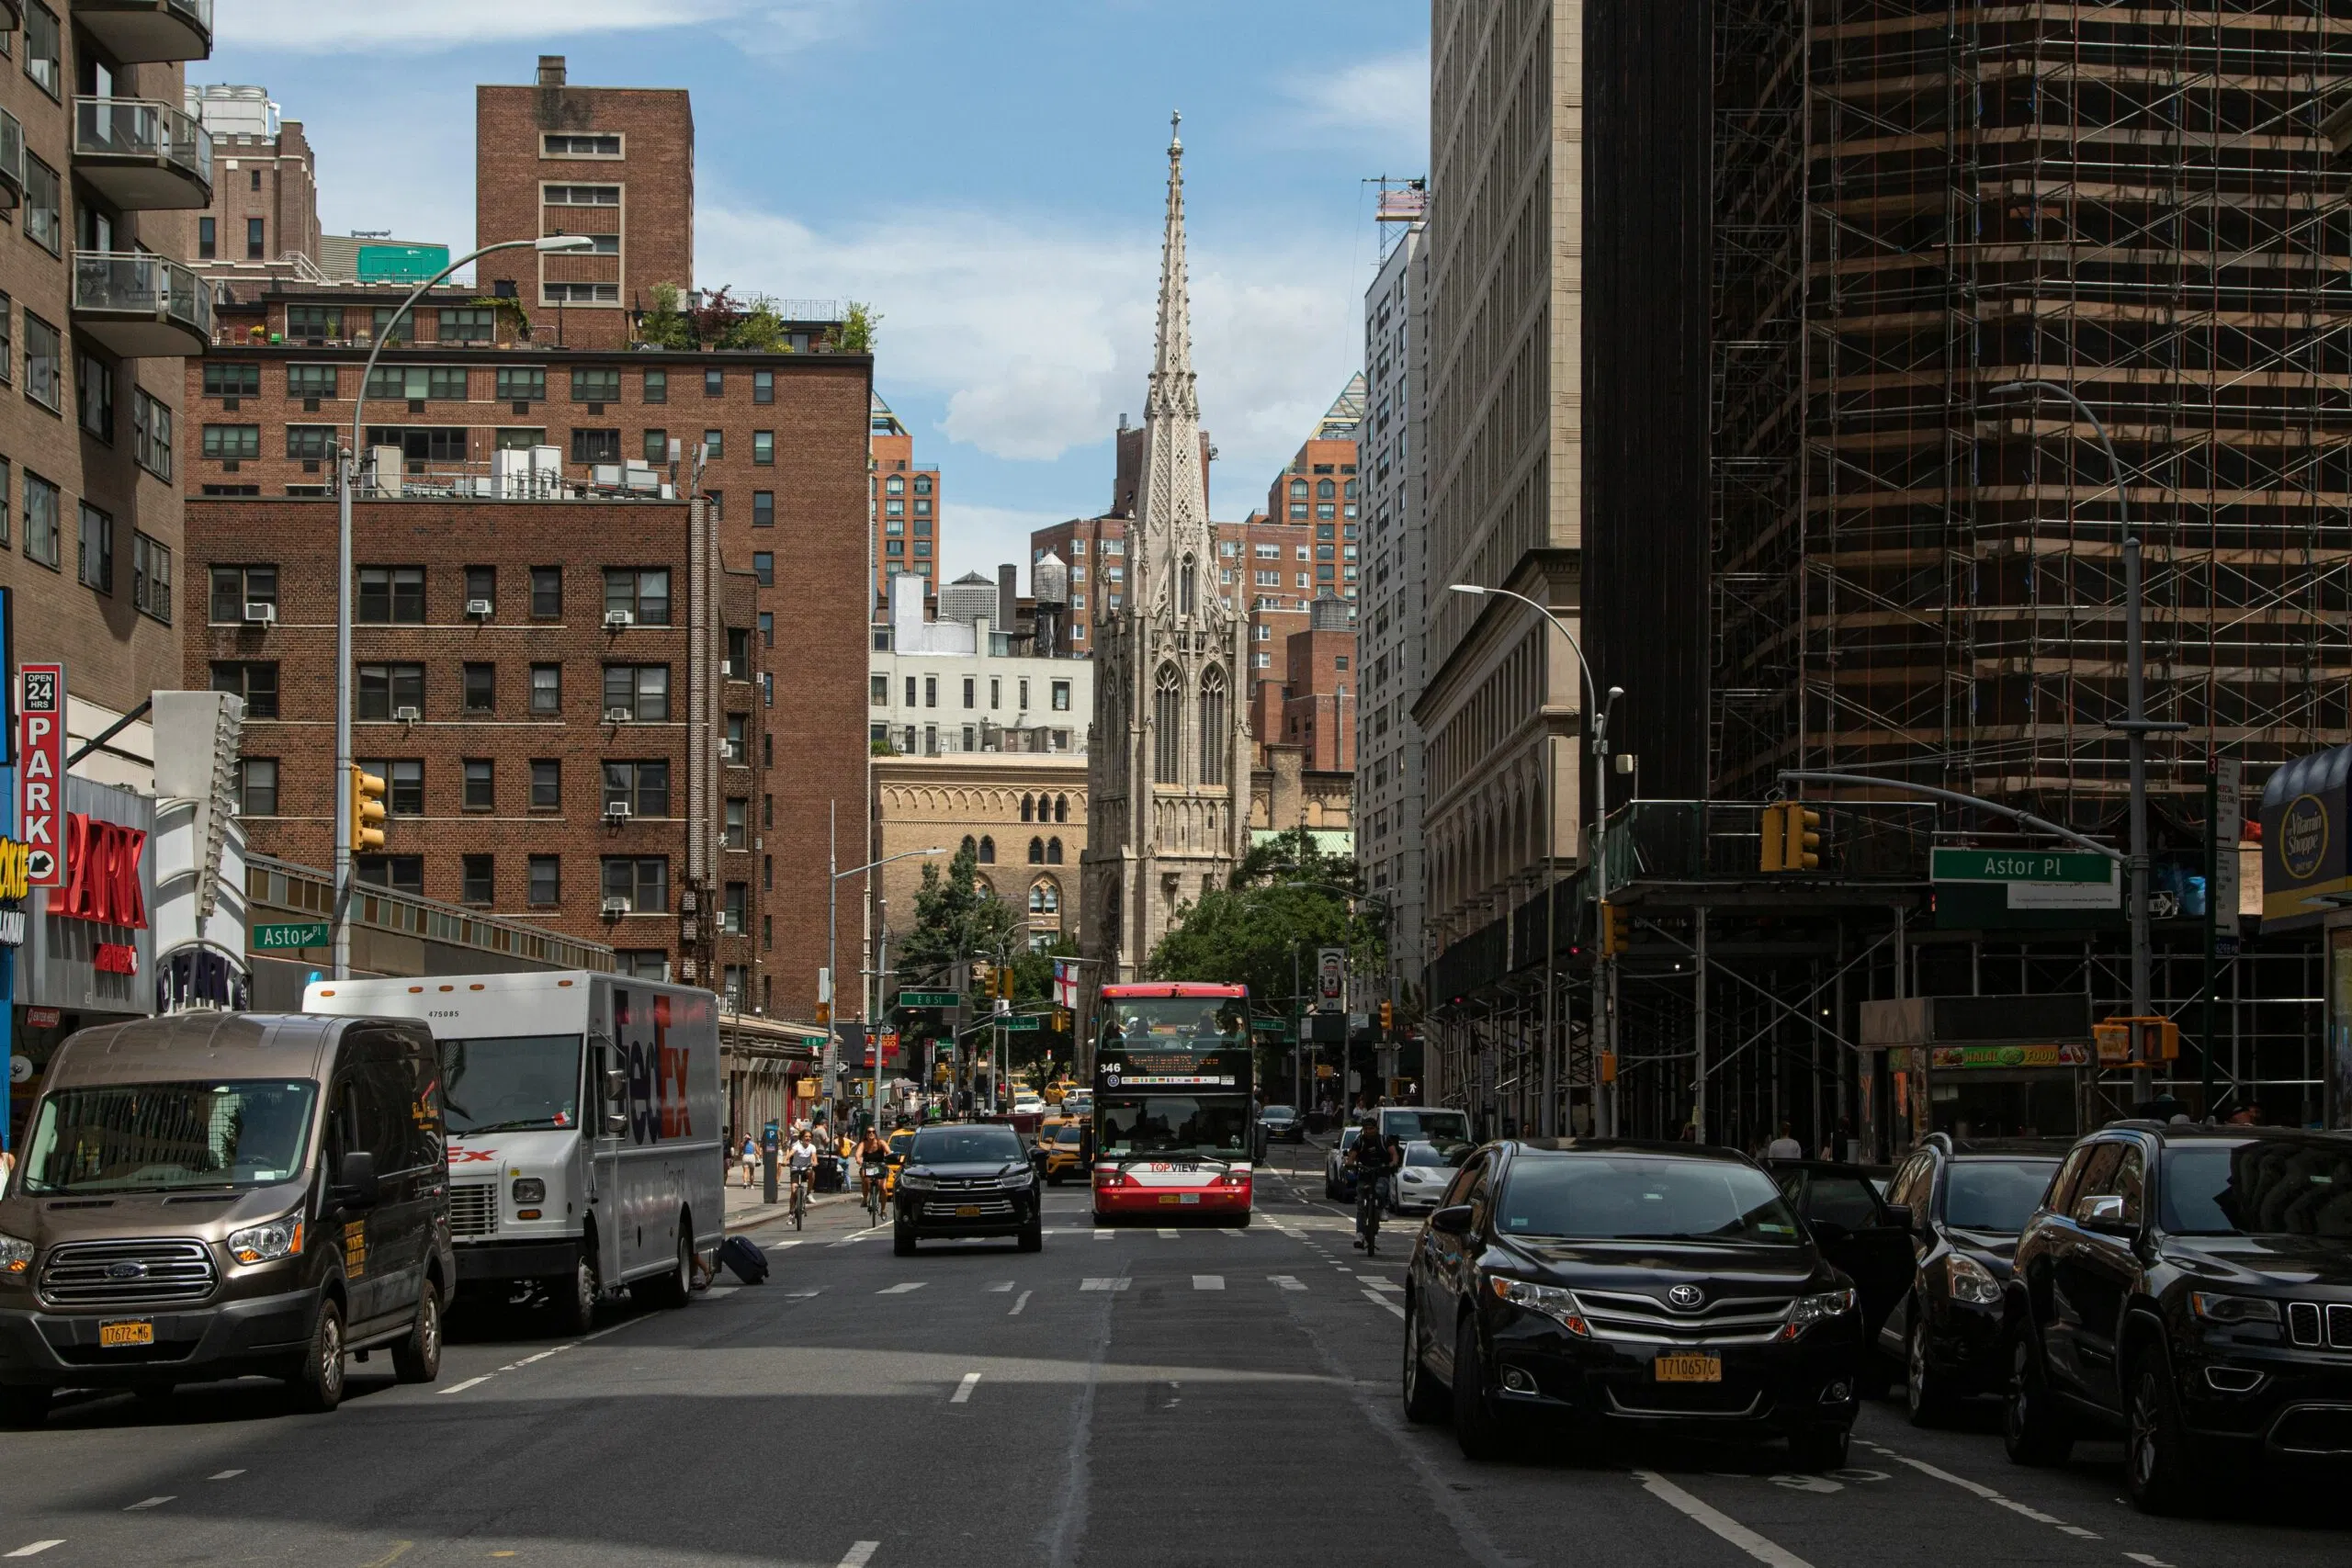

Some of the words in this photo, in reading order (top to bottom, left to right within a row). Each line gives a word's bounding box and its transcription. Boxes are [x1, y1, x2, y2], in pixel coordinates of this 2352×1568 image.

[28, 674, 52, 682] OPEN
[28, 682, 52, 700] 24
[26, 716, 53, 844] PARK
[2291, 811, 2322, 835] Vitamin
[2288, 834, 2319, 856] Shoppe
[46, 812, 149, 930] PARK
[1984, 857, 2035, 875] Astor
[2044, 858, 2062, 875] Pl
[2153, 899, 2167, 911] WAY
[264, 927, 307, 945] Astor
[312, 926, 322, 937] Pl
[171, 952, 232, 1005] PARK
[918, 996, 922, 1004] E
[925, 996, 931, 1004] 8
[934, 996, 942, 1004] St
[1965, 1051, 1998, 1062] HALAL
[2027, 1050, 2056, 1062] FOOD
[614, 988, 693, 1145] FedEx
[1100, 1063, 1121, 1073] 346
[769, 1130, 775, 1138] P
[1661, 1359, 1715, 1375] T710657C
